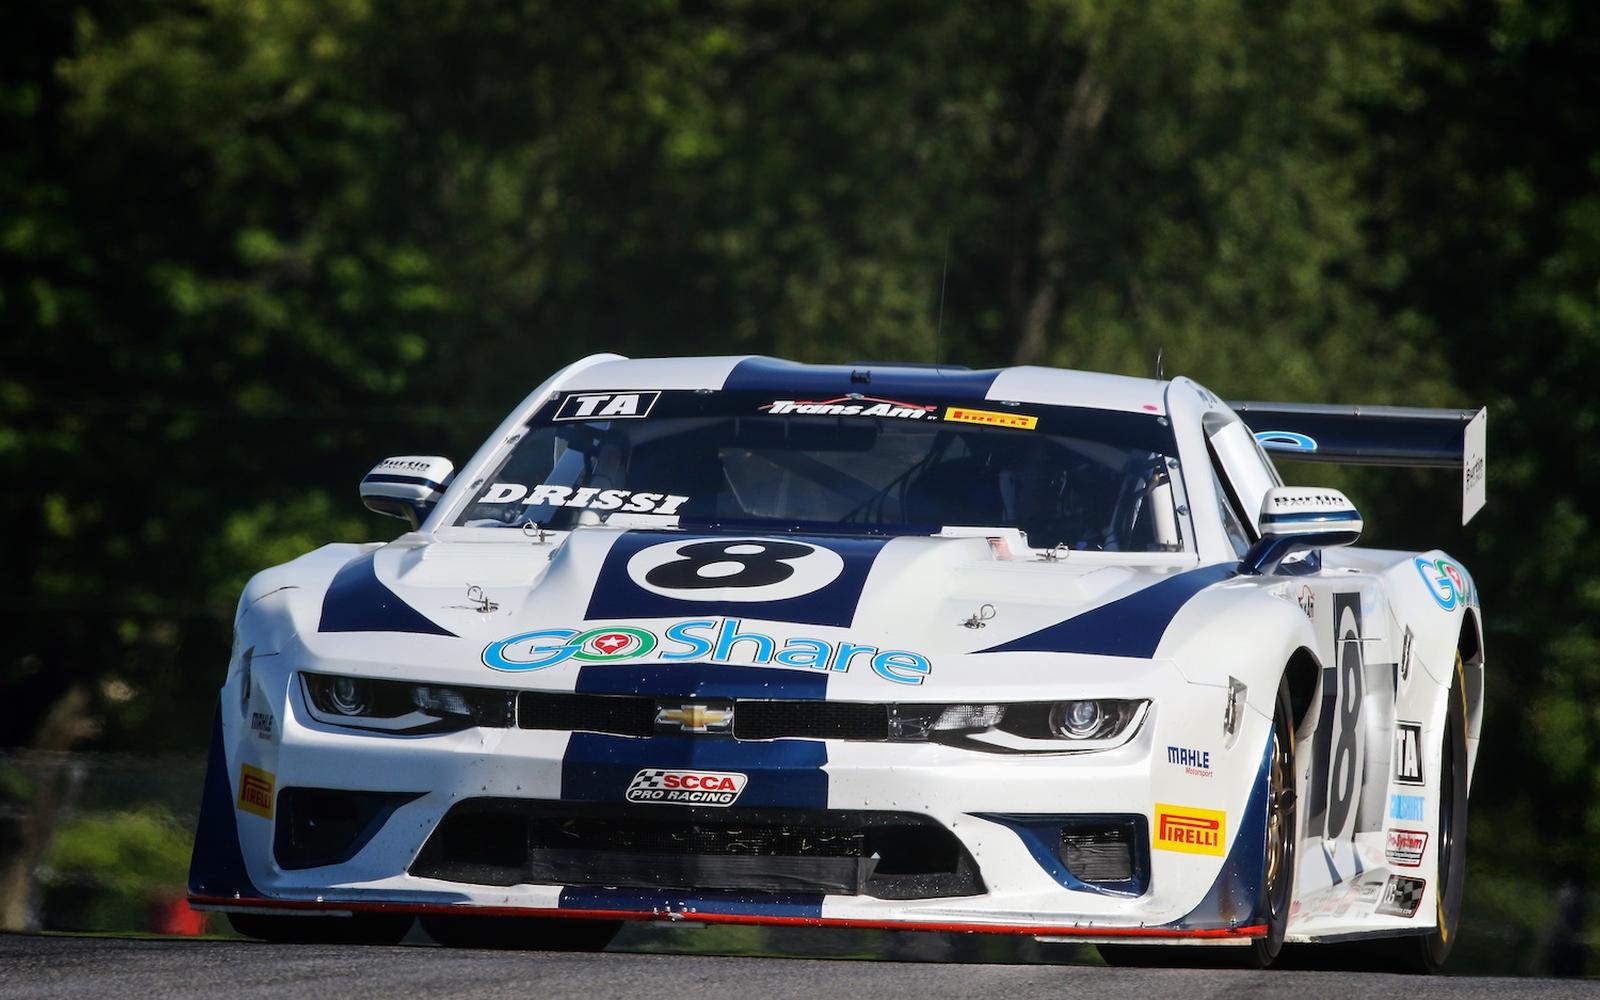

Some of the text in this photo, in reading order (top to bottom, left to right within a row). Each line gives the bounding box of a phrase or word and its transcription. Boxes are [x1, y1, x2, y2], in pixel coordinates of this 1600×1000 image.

[575, 394, 640, 417] TA
[768, 400, 863, 415] Trans
[860, 403, 927, 419] Am
[952, 410, 1029, 427] PIRELLI
[478, 482, 689, 516] DRISSI
[645, 539, 816, 588] 8
[1327, 629, 1362, 840] 8
[1167, 746, 1209, 769] MAHLE
[1396, 729, 1419, 778] TA
[663, 775, 736, 791] SCCA
[1184, 766, 1214, 778] Motorsport
[241, 773, 273, 810] PIRELLI
[630, 789, 733, 803] PRO RACING
[1159, 812, 1220, 847] PIRELLI
